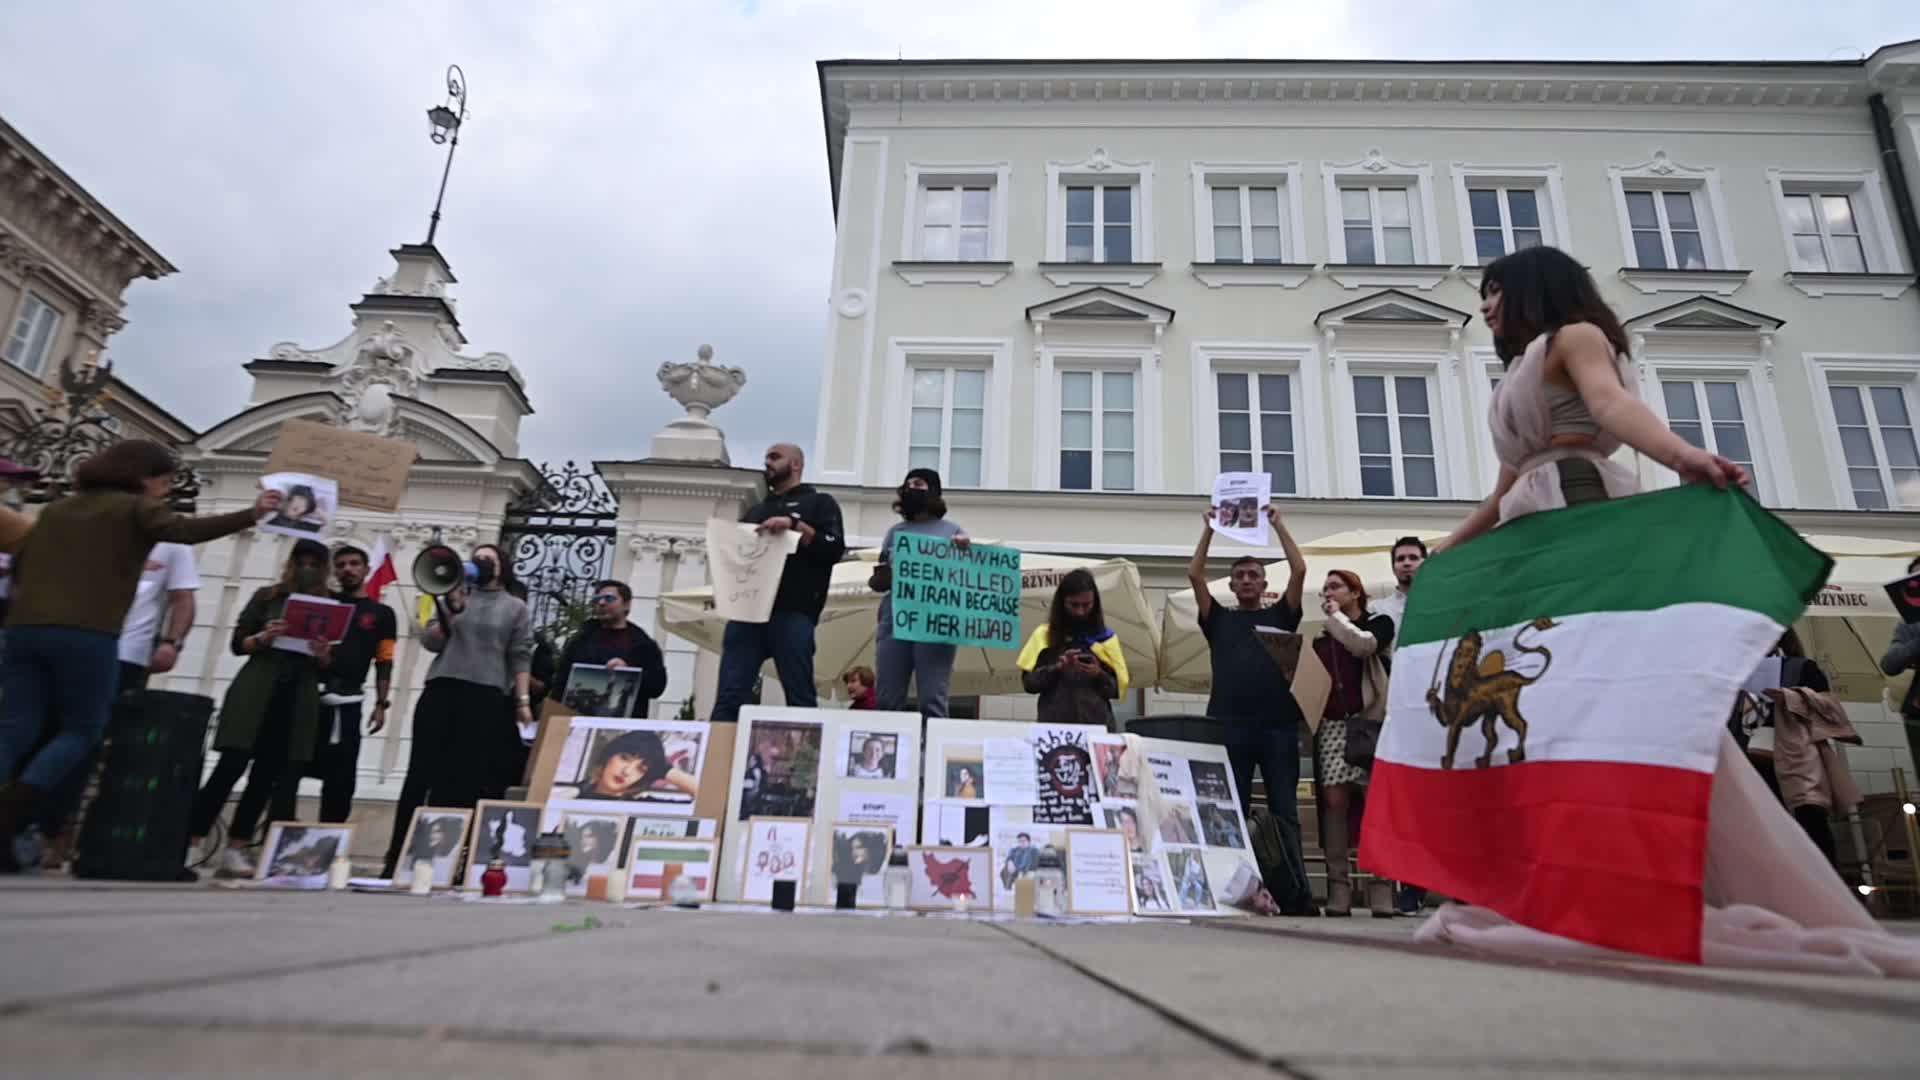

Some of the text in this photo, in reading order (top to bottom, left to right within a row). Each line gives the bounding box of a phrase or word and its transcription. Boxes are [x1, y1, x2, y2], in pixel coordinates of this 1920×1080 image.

[896, 536, 1019, 571] A WOMAN HAS
[899, 560, 1014, 595] BEEN KILLED
[896, 582, 1020, 617] IN IRAN BECAUSE
[895, 610, 1014, 643] OF HER HIJAB
